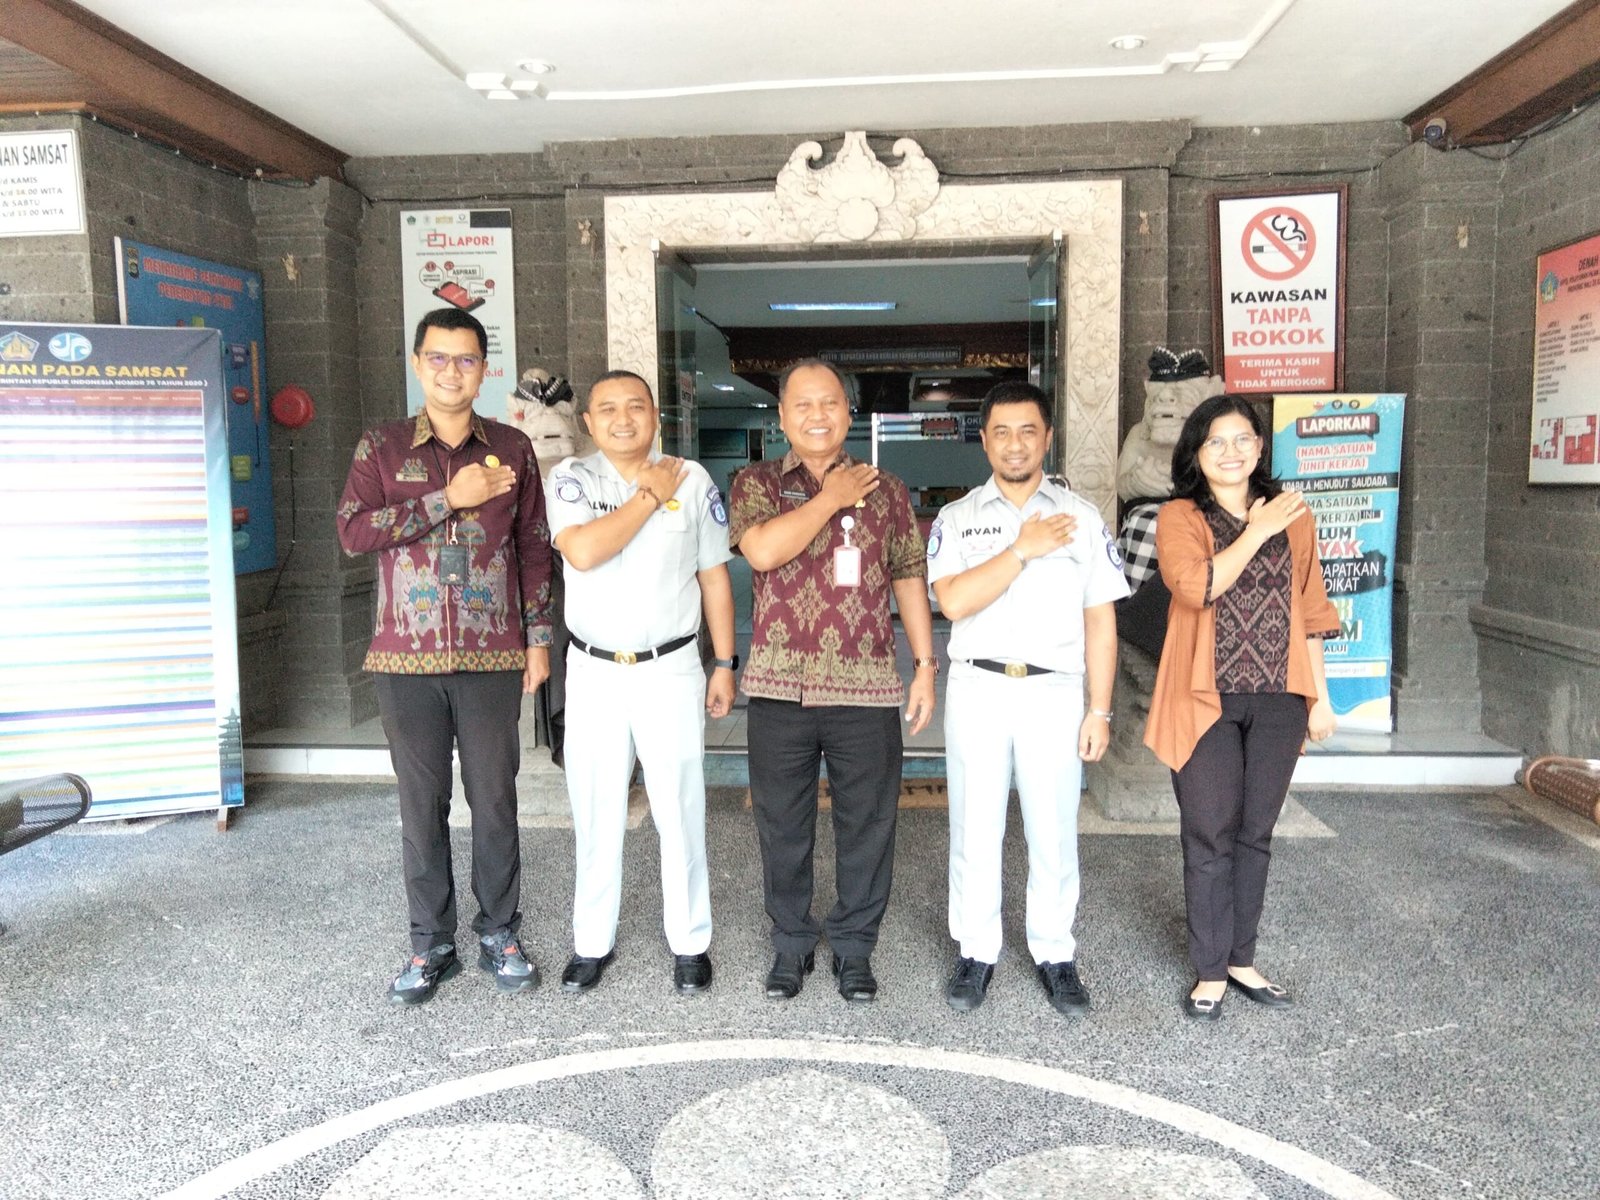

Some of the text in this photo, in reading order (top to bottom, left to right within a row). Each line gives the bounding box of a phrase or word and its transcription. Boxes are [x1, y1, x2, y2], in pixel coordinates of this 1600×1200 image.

[23, 144, 67, 165] SAMSAT
[10, 176, 38, 184] KAMIS
[40, 186, 63, 195] WITA
[41, 208, 64, 216] WITA
[448, 235, 495, 247] LAPOR!
[1230, 288, 1328, 304] KAWASAN
[1246, 307, 1312, 325] TANPA
[1232, 328, 1325, 347] ROKOK
[1240, 357, 1320, 368] TERIMA KASIH
[42, 364, 101, 377] PADA
[104, 365, 189, 378] SAMSAT
[485, 367, 504, 378] o.id
[1260, 368, 1300, 378] UNTUK
[1234, 377, 1327, 389] TIDAK MEROKOK
[1302, 415, 1371, 434] LAPORKAN
[1332, 442, 1374, 455] SATUAN
[1313, 478, 1349, 491] MENURUT
[1351, 476, 1388, 487] SAUDARA
[1308, 495, 1369, 509] MA SATUAN
[961, 526, 1002, 539] IRVAN
[1318, 527, 1352, 541] LUM
[1318, 541, 1359, 557] YAK
[1321, 561, 1381, 578] APATKAN
[1323, 577, 1361, 593] DIKAT
[1324, 644, 1348, 653] ALUI
